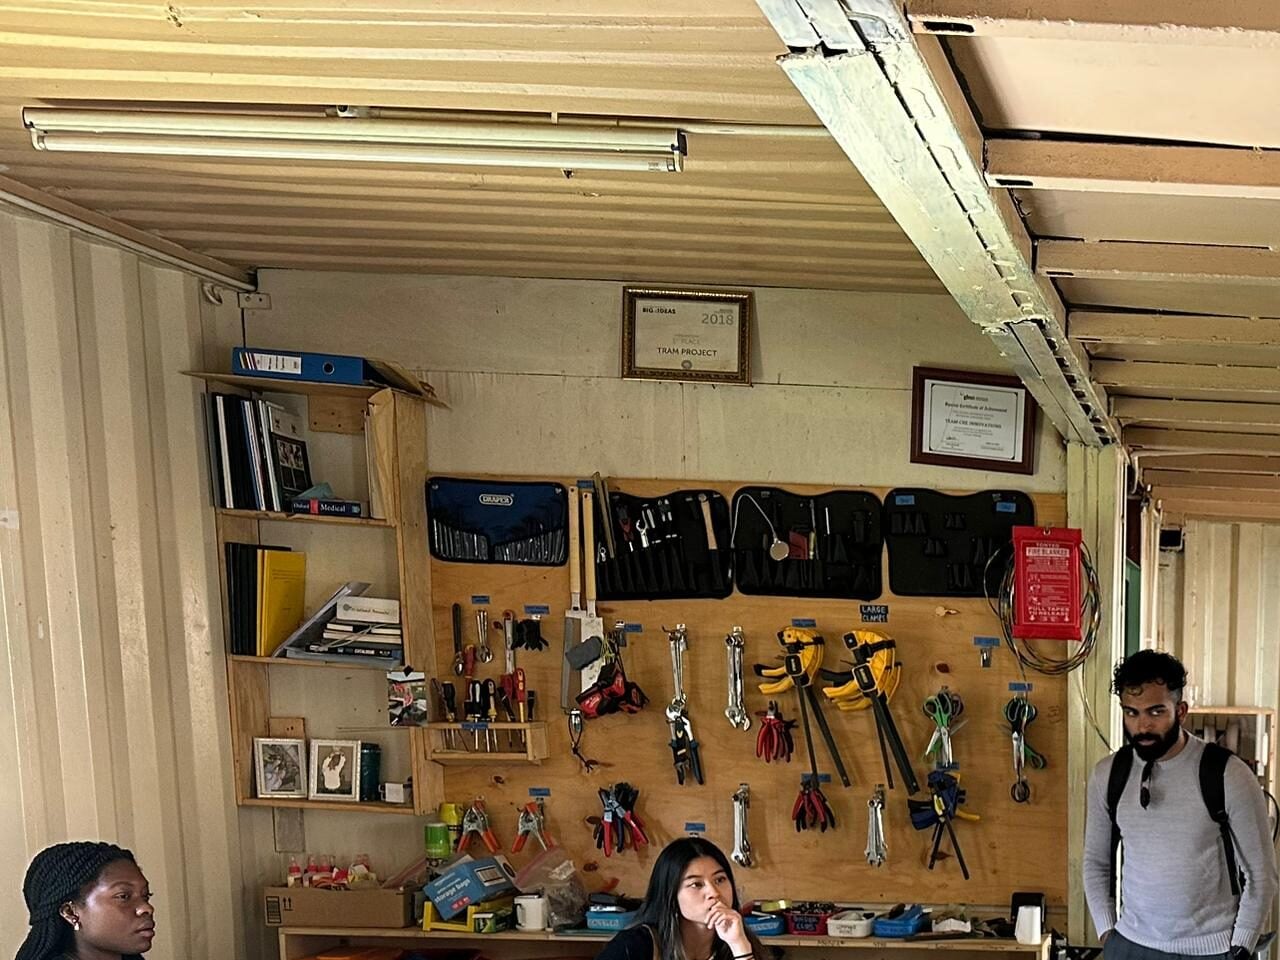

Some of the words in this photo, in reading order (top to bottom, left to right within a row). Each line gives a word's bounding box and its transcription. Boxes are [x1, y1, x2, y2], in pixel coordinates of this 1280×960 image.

[701, 313, 734, 325] 2018
[657, 347, 680, 355] TRAM
[681, 348, 718, 357] PROJECT
[320, 503, 346, 512] Medical
[862, 605, 886, 613] LARGE
